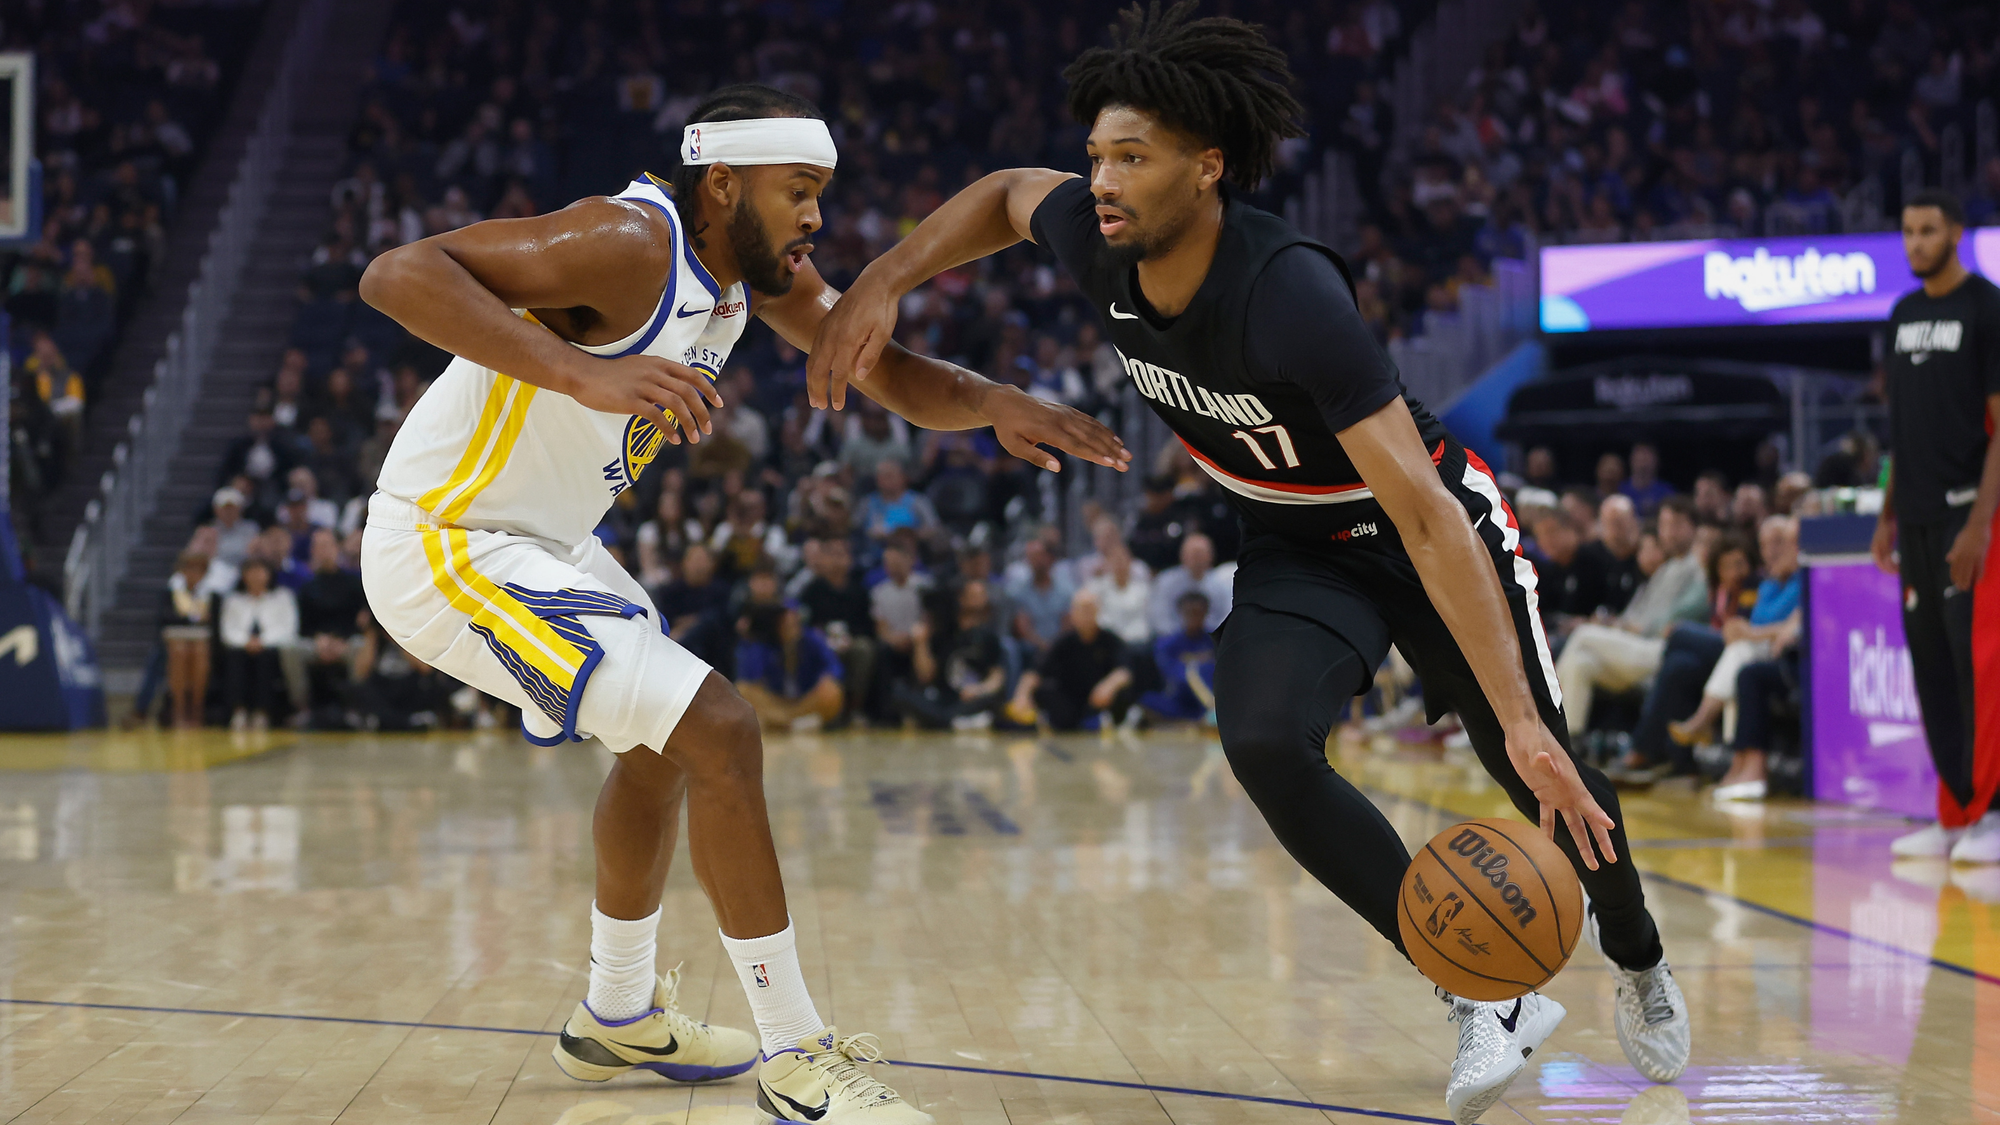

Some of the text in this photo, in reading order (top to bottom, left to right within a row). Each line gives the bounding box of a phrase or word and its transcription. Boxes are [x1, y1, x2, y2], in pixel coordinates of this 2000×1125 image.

[1704, 246, 1876, 301] Rakuten
[1112, 343, 1273, 426] PORTLAND
[1231, 424, 1300, 471] 17
[1448, 828, 1537, 930] Wilson
